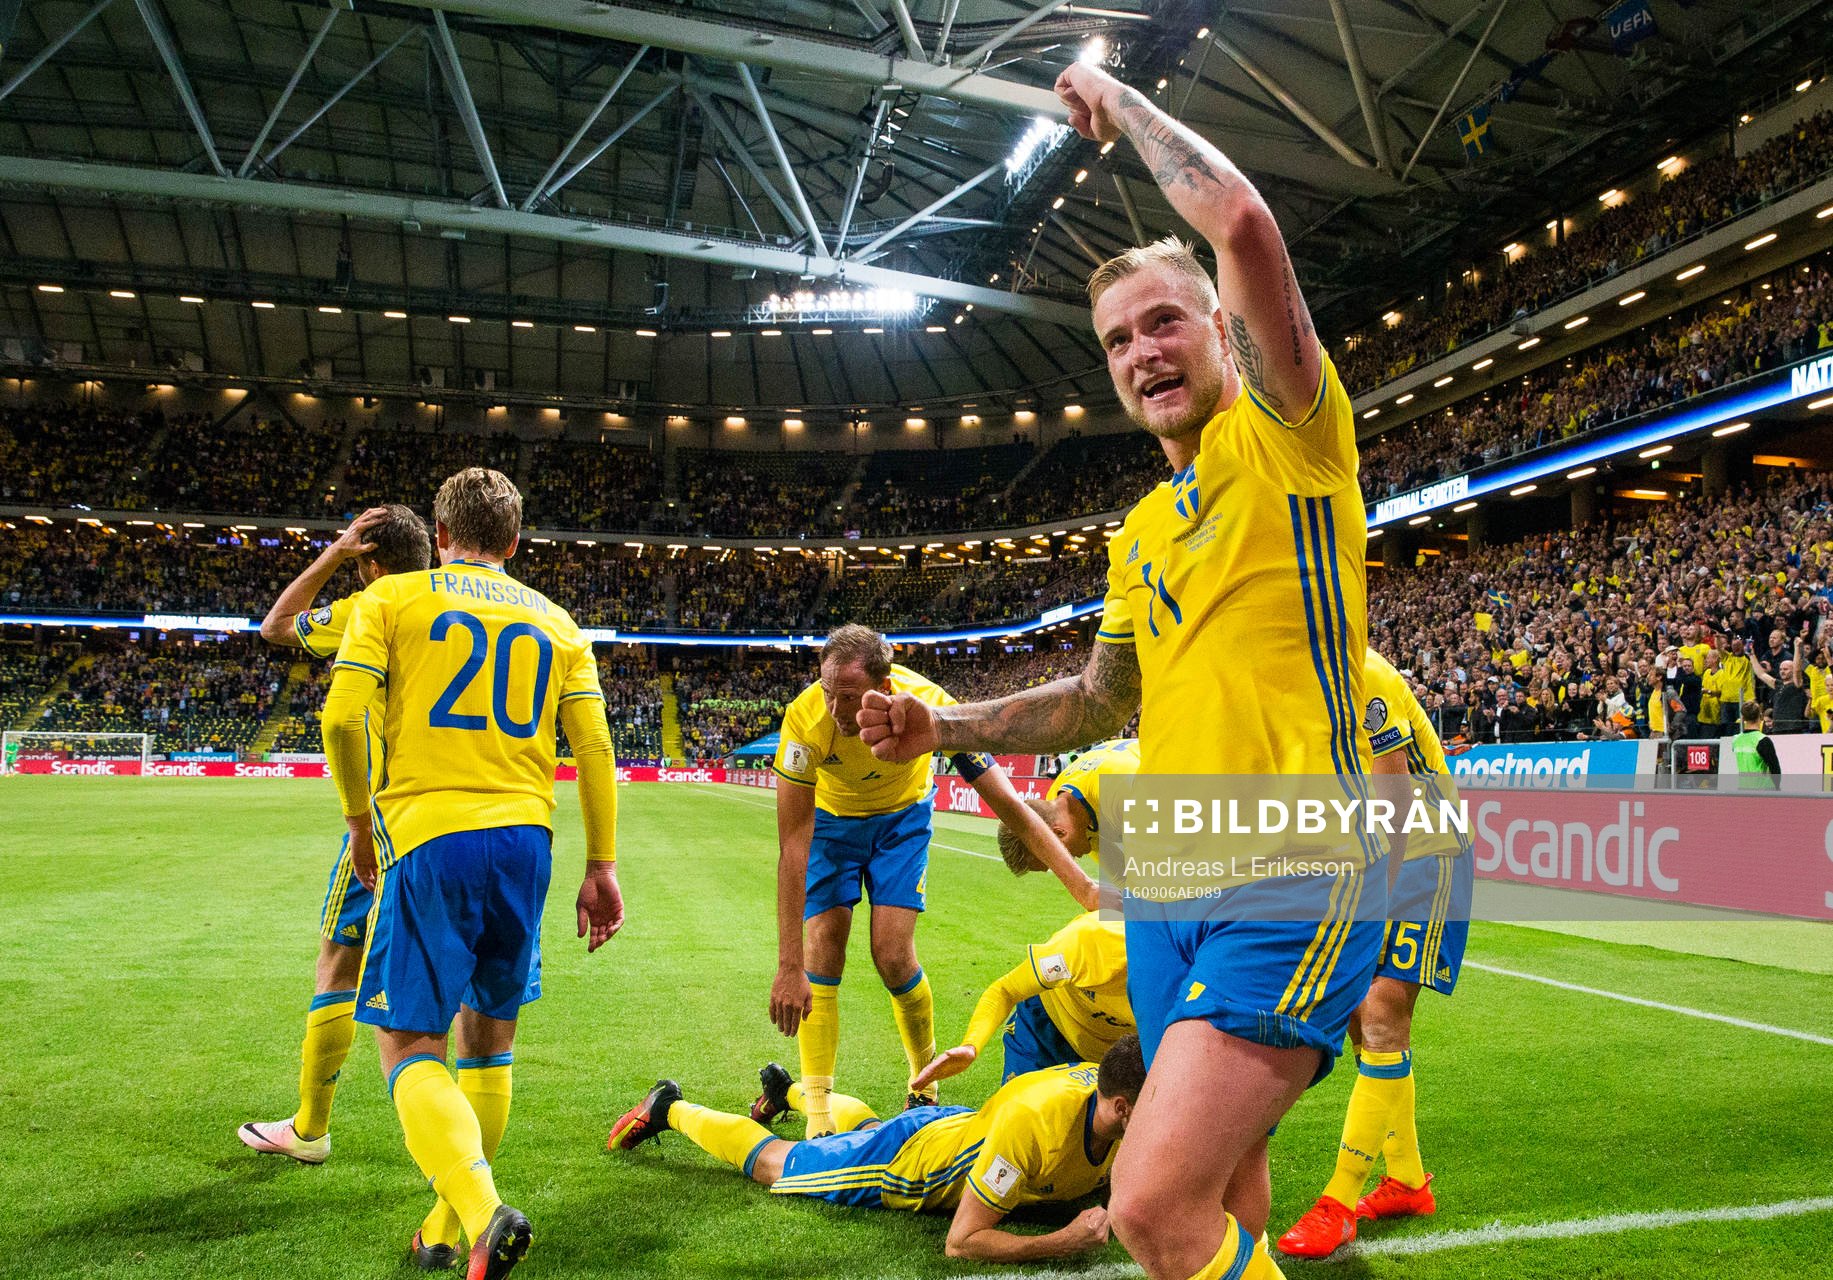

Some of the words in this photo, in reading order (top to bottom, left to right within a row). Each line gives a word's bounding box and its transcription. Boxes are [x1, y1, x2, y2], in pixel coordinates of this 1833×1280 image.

[1610, 9, 1653, 38] UEFA
[1791, 355, 1833, 398] NAT
[1375, 474, 1469, 523] NATIONALSPORTEN
[430, 572, 548, 614] FRANSSON
[429, 610, 553, 739] 20
[1372, 729, 1400, 747] RESPECT
[51, 761, 115, 775] Scandic
[144, 762, 206, 776] Scandic
[234, 763, 294, 777] Scandic
[1454, 749, 1591, 788] postnord
[1689, 751, 1707, 766] 108
[657, 769, 712, 782] Scandic
[1476, 800, 1680, 892] Scandic
[365, 1000, 390, 1011] adidas
